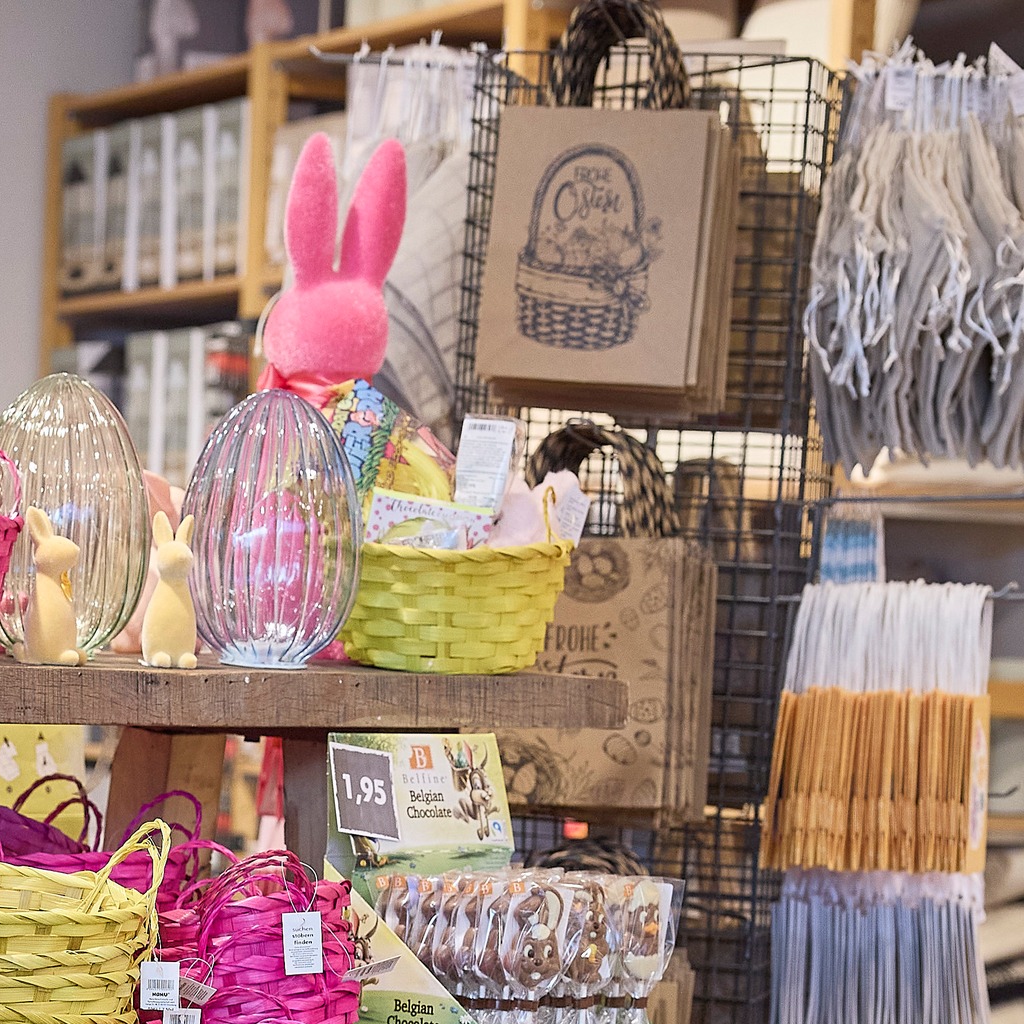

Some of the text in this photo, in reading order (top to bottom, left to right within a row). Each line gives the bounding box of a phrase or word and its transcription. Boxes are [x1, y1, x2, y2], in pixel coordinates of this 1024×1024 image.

[544, 622, 598, 652] FROHE
[402, 773, 446, 784] Belfine
[342, 773, 387, 806] 1,95
[409, 790, 444, 804] Belgian
[406, 807, 452, 820] Chocolate
[393, 998, 434, 1017] Belgian
